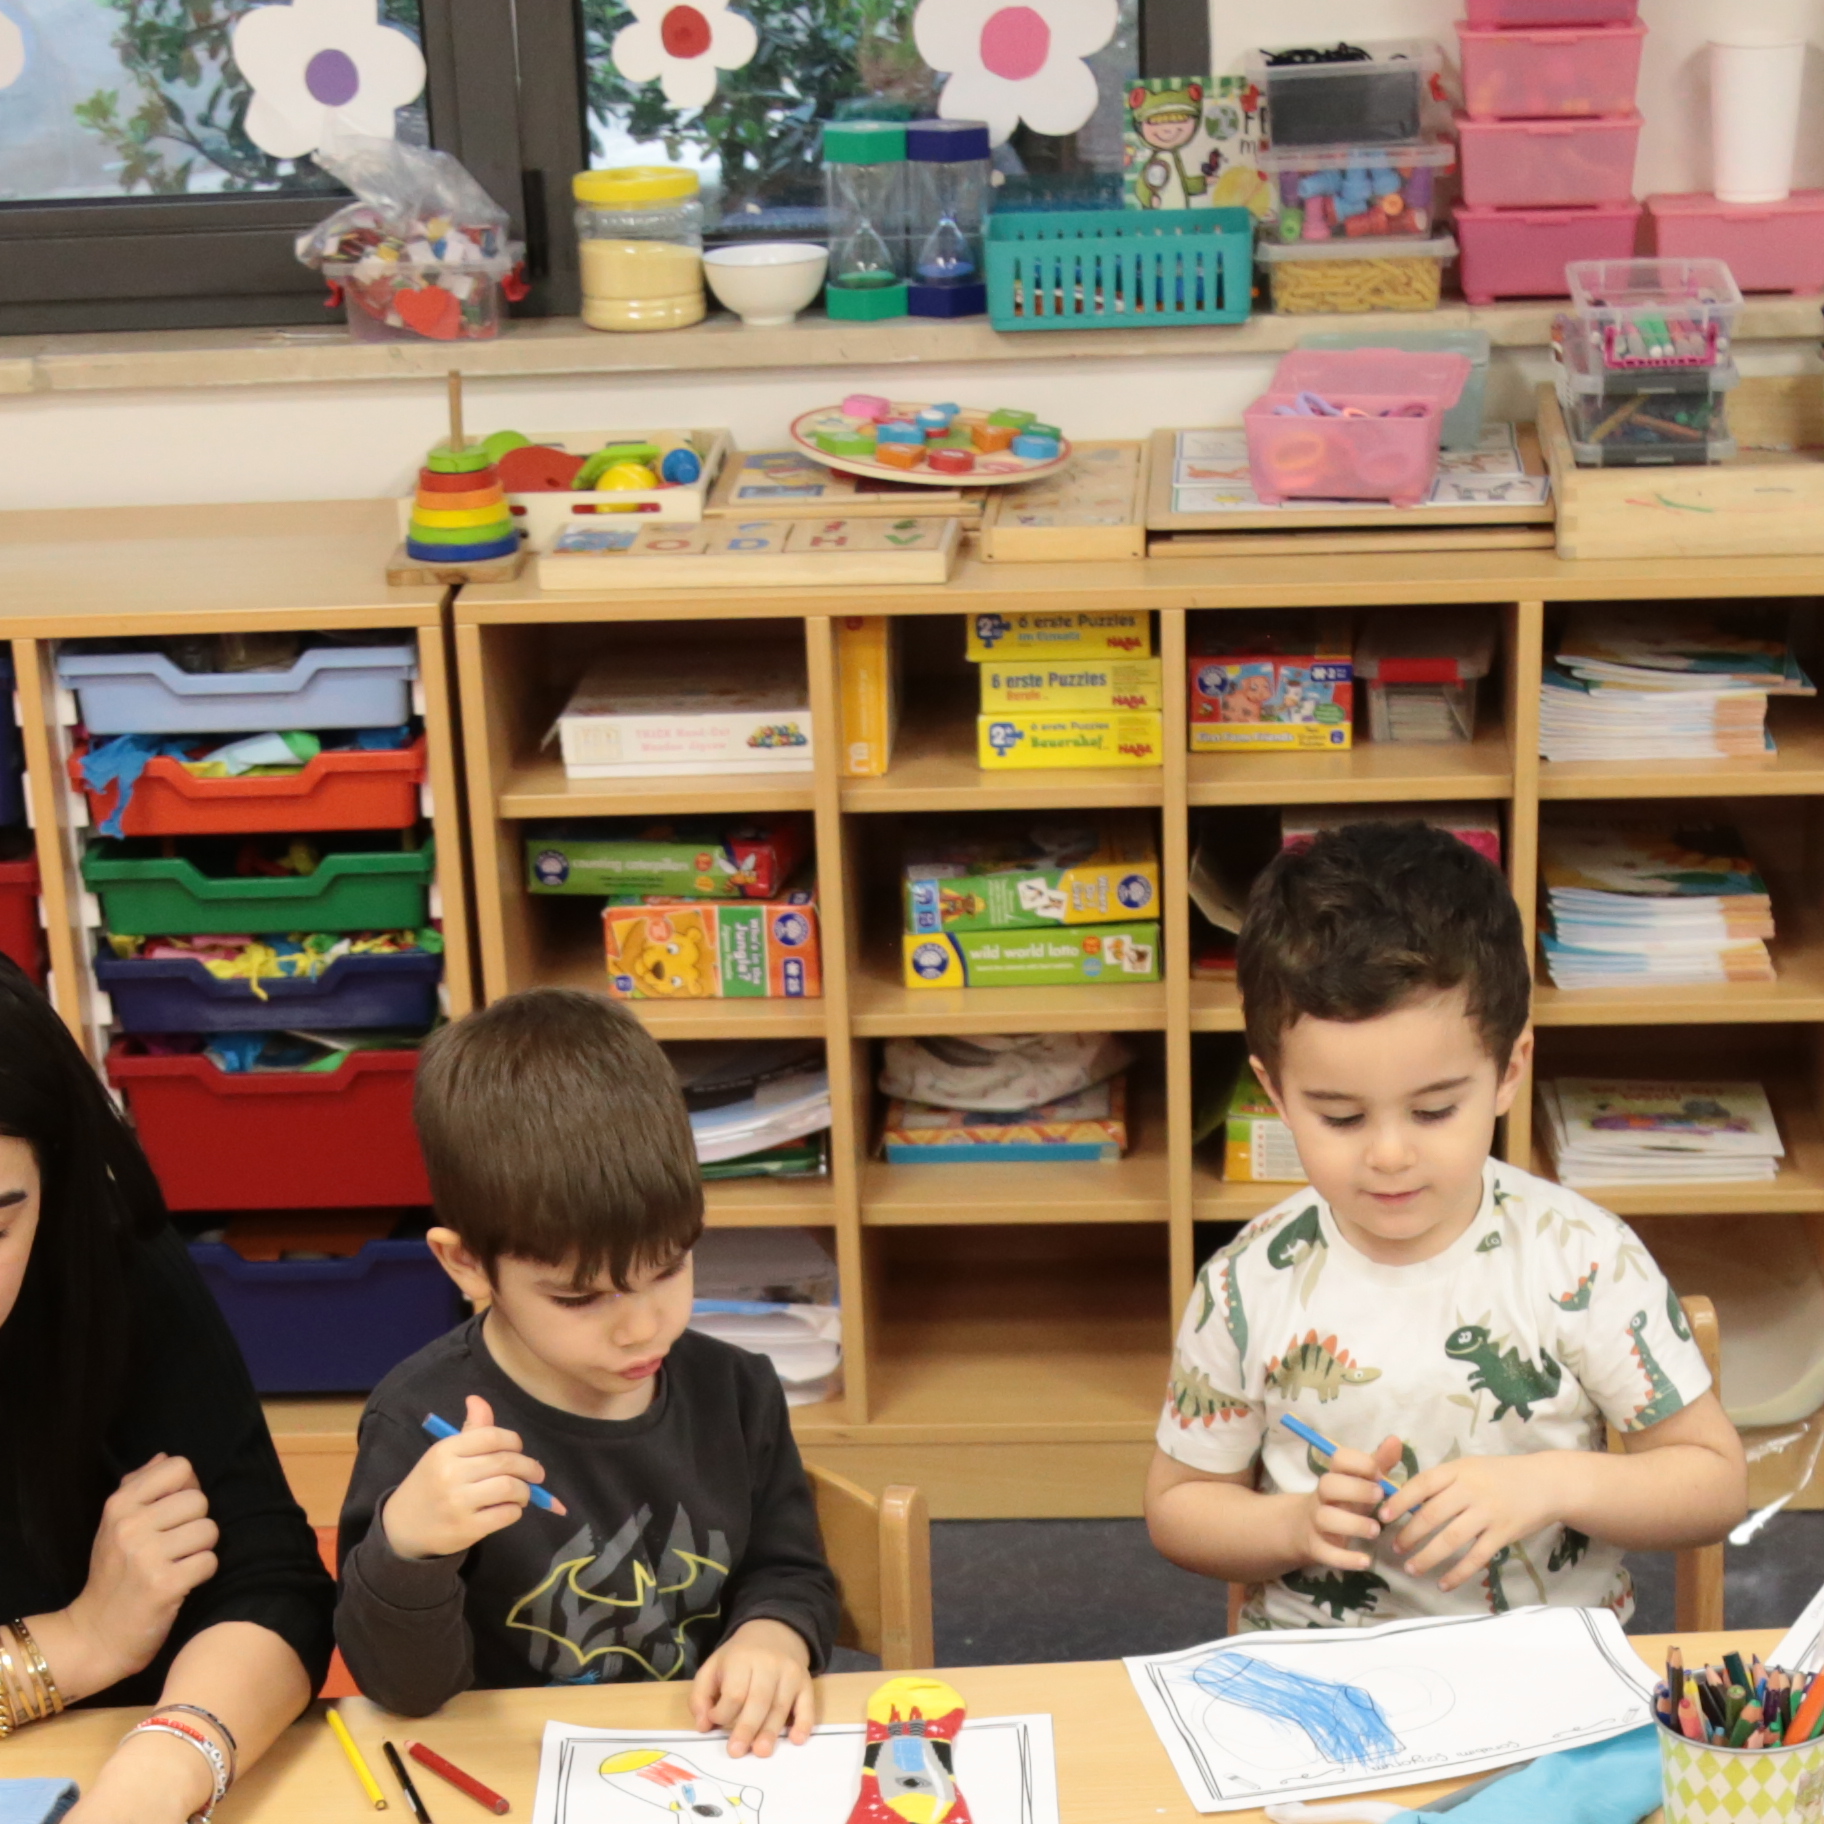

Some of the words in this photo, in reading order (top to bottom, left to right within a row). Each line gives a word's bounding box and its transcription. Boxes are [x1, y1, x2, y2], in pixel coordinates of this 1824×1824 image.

[727, 538, 770, 551] D
[810, 535, 847, 547] H
[1078, 614, 1136, 628] Puzzles
[1006, 674, 1043, 688] erste
[1048, 671, 1107, 687] Puzzles
[970, 944, 1000, 960] wild
[1004, 943, 1045, 959] world
[1048, 943, 1080, 957] lotto
